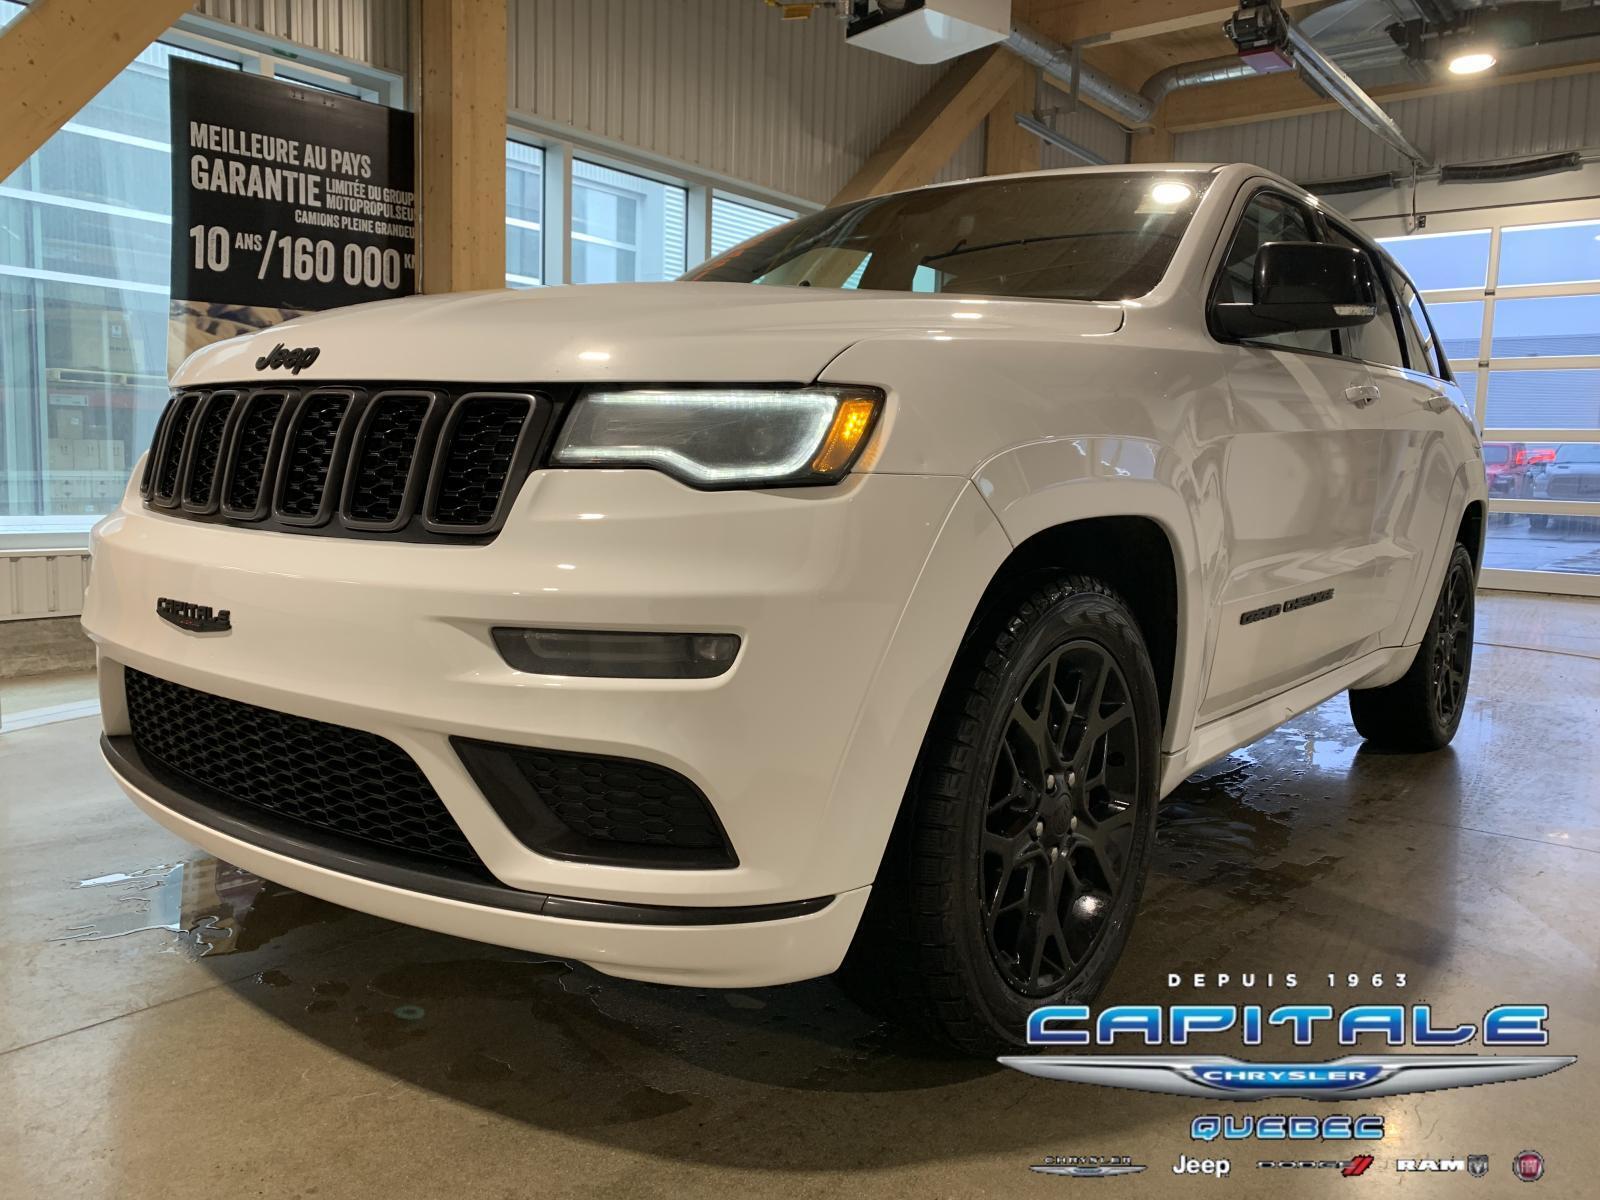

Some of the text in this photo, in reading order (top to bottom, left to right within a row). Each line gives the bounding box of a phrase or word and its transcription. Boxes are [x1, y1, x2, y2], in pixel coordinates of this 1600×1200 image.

[190, 121, 372, 179] MEILLEURE AU PAYS
[190, 154, 322, 207] GARANTIE
[325, 177, 414, 206] LIMITÉE DU GROUP
[326, 193, 415, 221] MOTOPROPULSEU
[294, 209, 415, 239] CAMIONS PLEINE GRANDEU
[189, 224, 230, 272] 10
[234, 231, 263, 252] ANS
[343, 242, 401, 291] 000
[255, 342, 321, 376] Jeep
[156, 597, 231, 624] CAPITALE
